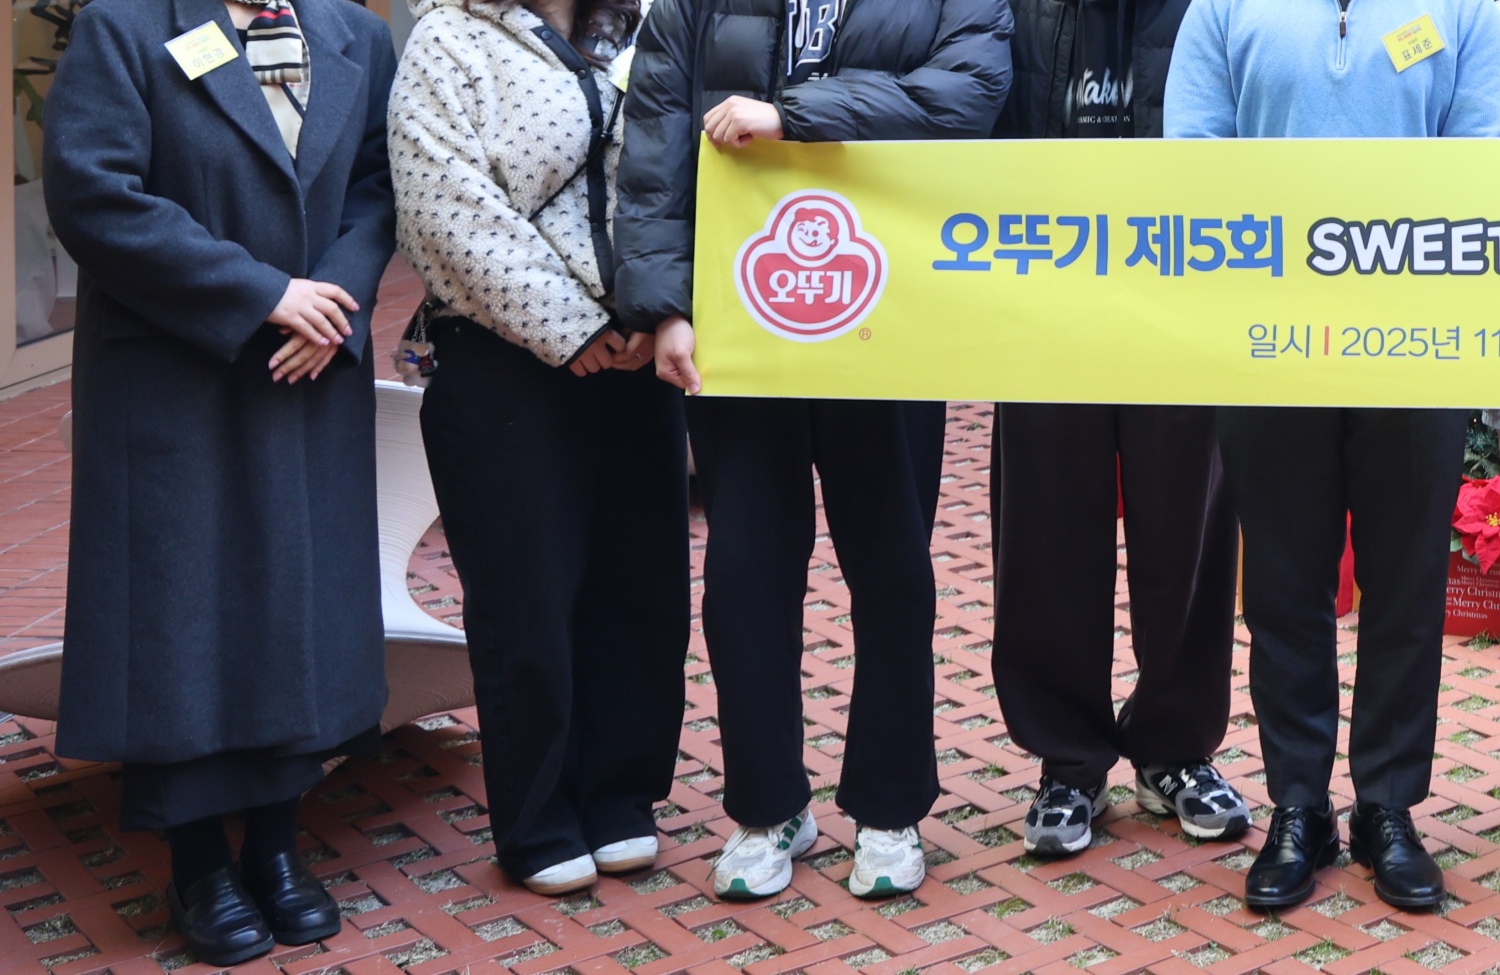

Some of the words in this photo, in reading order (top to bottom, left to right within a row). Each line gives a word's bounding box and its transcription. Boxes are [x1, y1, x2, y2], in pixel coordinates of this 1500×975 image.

[932, 212, 1108, 277] 오뚜기
[1125, 213, 1284, 278] 제5회
[768, 269, 853, 305] 오뚜기
[1248, 323, 1311, 359] 일시
[1341, 326, 1461, 360] 2025년
[1457, 564, 1478, 576] Merry
[1446, 587, 1465, 599] erry
[1453, 596, 1481, 611] Merry
[1452, 609, 1488, 619] Christmas
[1158, 774, 1178, 796] N
